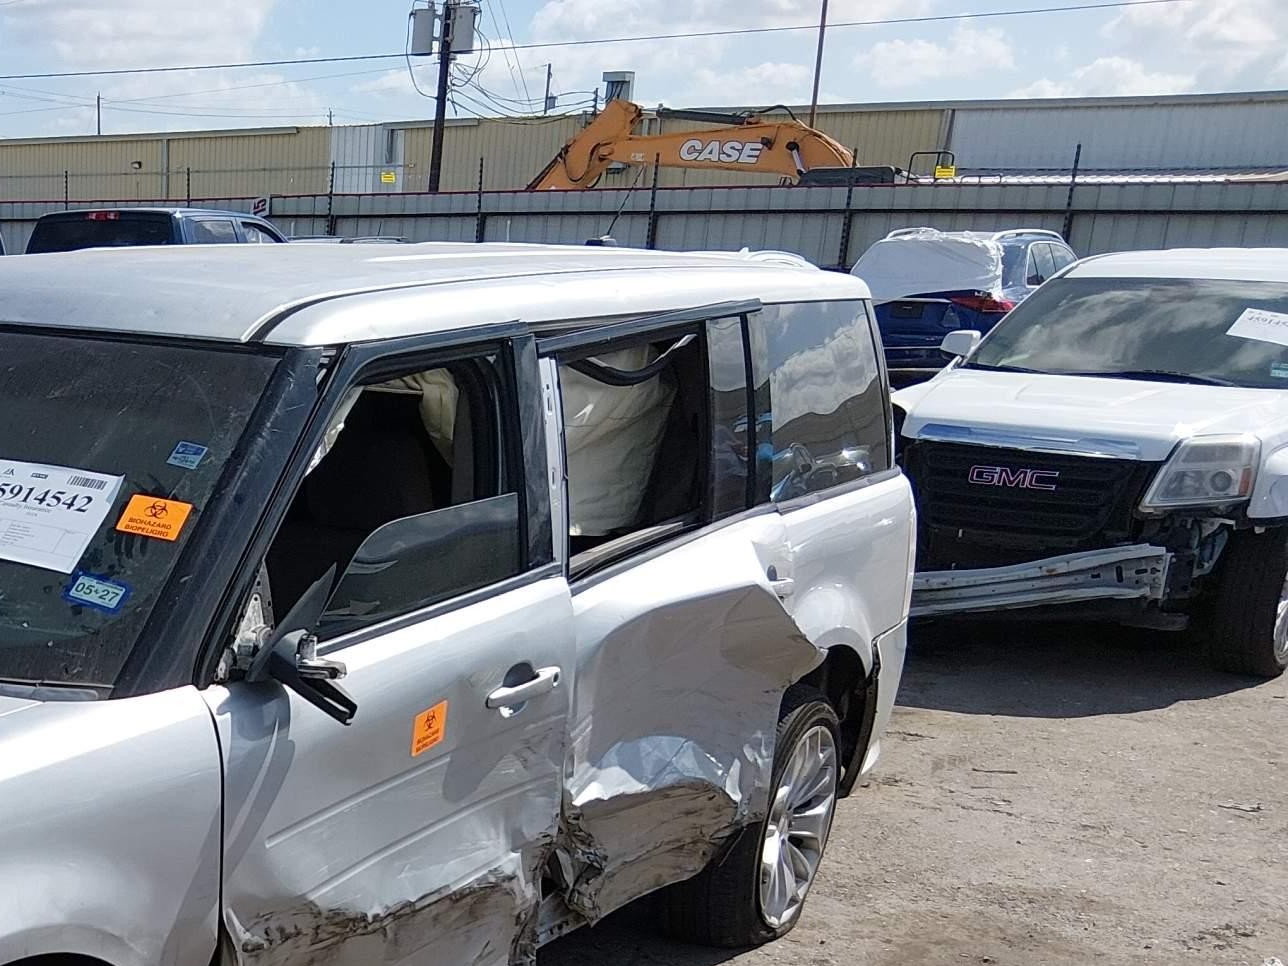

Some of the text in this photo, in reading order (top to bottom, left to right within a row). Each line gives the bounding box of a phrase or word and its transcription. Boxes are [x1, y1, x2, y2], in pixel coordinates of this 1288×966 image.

[679, 138, 763, 164] CASE
[968, 465, 1059, 490] GMC
[124, 524, 170, 538] BIOPELIGRO
[128, 517, 172, 531] BIOHAZARD
[75, 582, 95, 595] 05
[98, 589, 119, 602] 27
